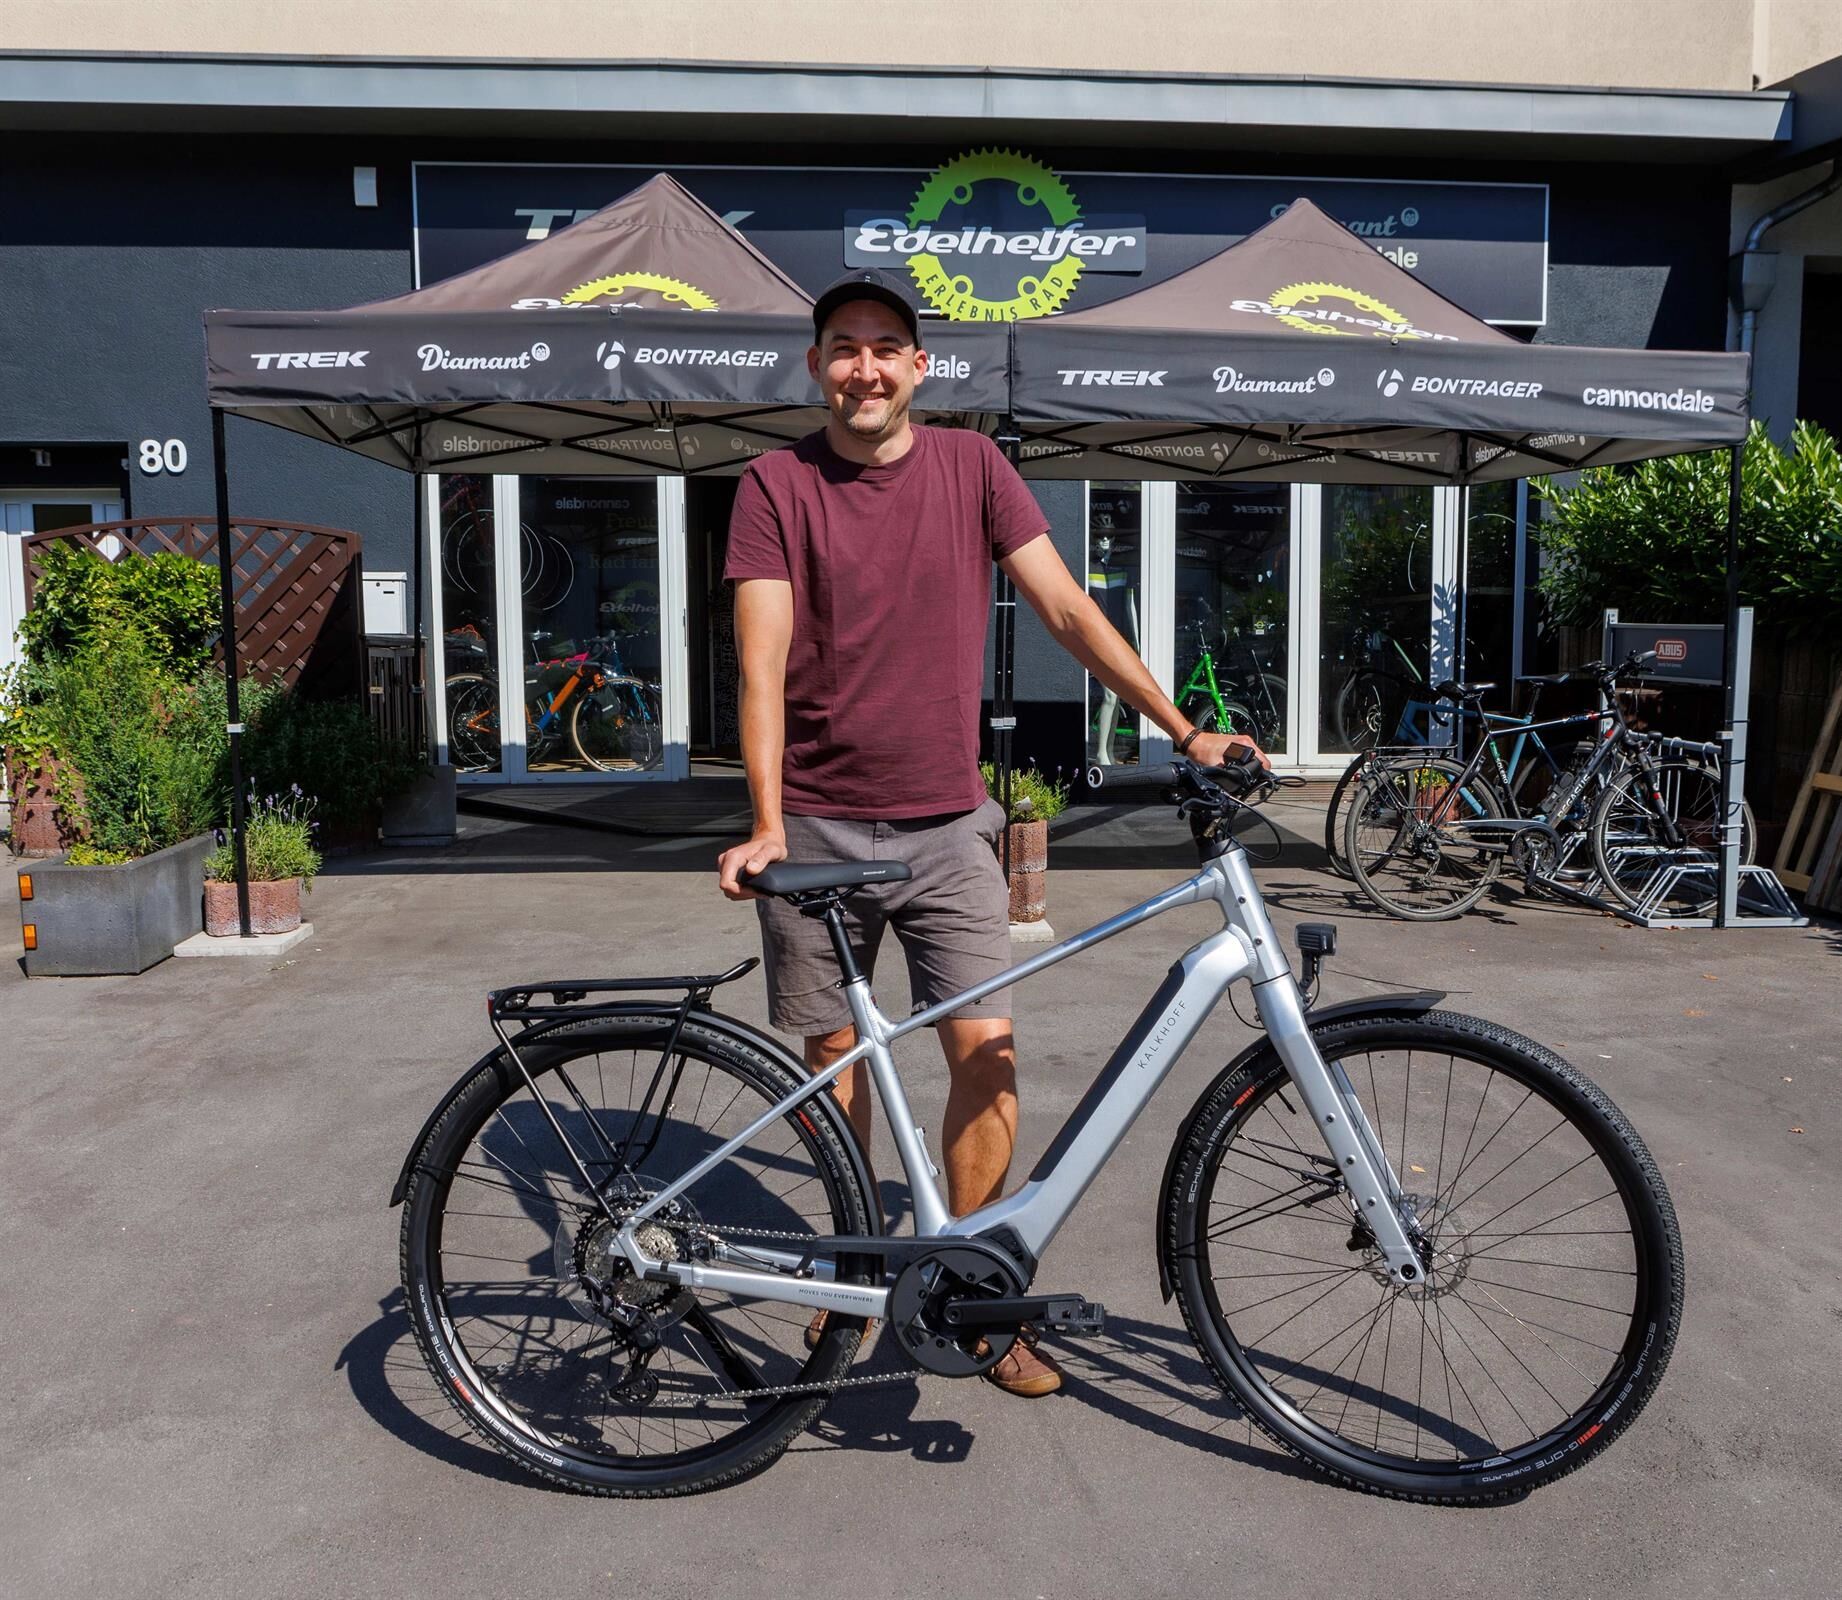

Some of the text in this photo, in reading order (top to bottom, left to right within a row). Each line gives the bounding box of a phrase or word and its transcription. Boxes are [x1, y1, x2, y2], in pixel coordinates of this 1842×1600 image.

[854, 218, 1137, 261] Edelhelfer
[925, 273, 1063, 322] ERLEBNIS RAD
[251, 350, 371, 369] TREK
[417, 343, 531, 371] Diamant
[633, 347, 779, 368] BONTRAGER
[1057, 370, 1168, 386] TREK
[1212, 366, 1319, 394] Diamant
[1411, 376, 1543, 399] BONTRAGER
[1582, 387, 1715, 413] cannondale
[139, 439, 188, 473] 80
[1658, 643, 1683, 656] ABUS
[1137, 1000, 1186, 1069] KALKHOFF
[1618, 1320, 1657, 1401] SCHWALBE
[491, 1421, 564, 1468] SCHWALBE
[1535, 1441, 1579, 1470] G-ONE
